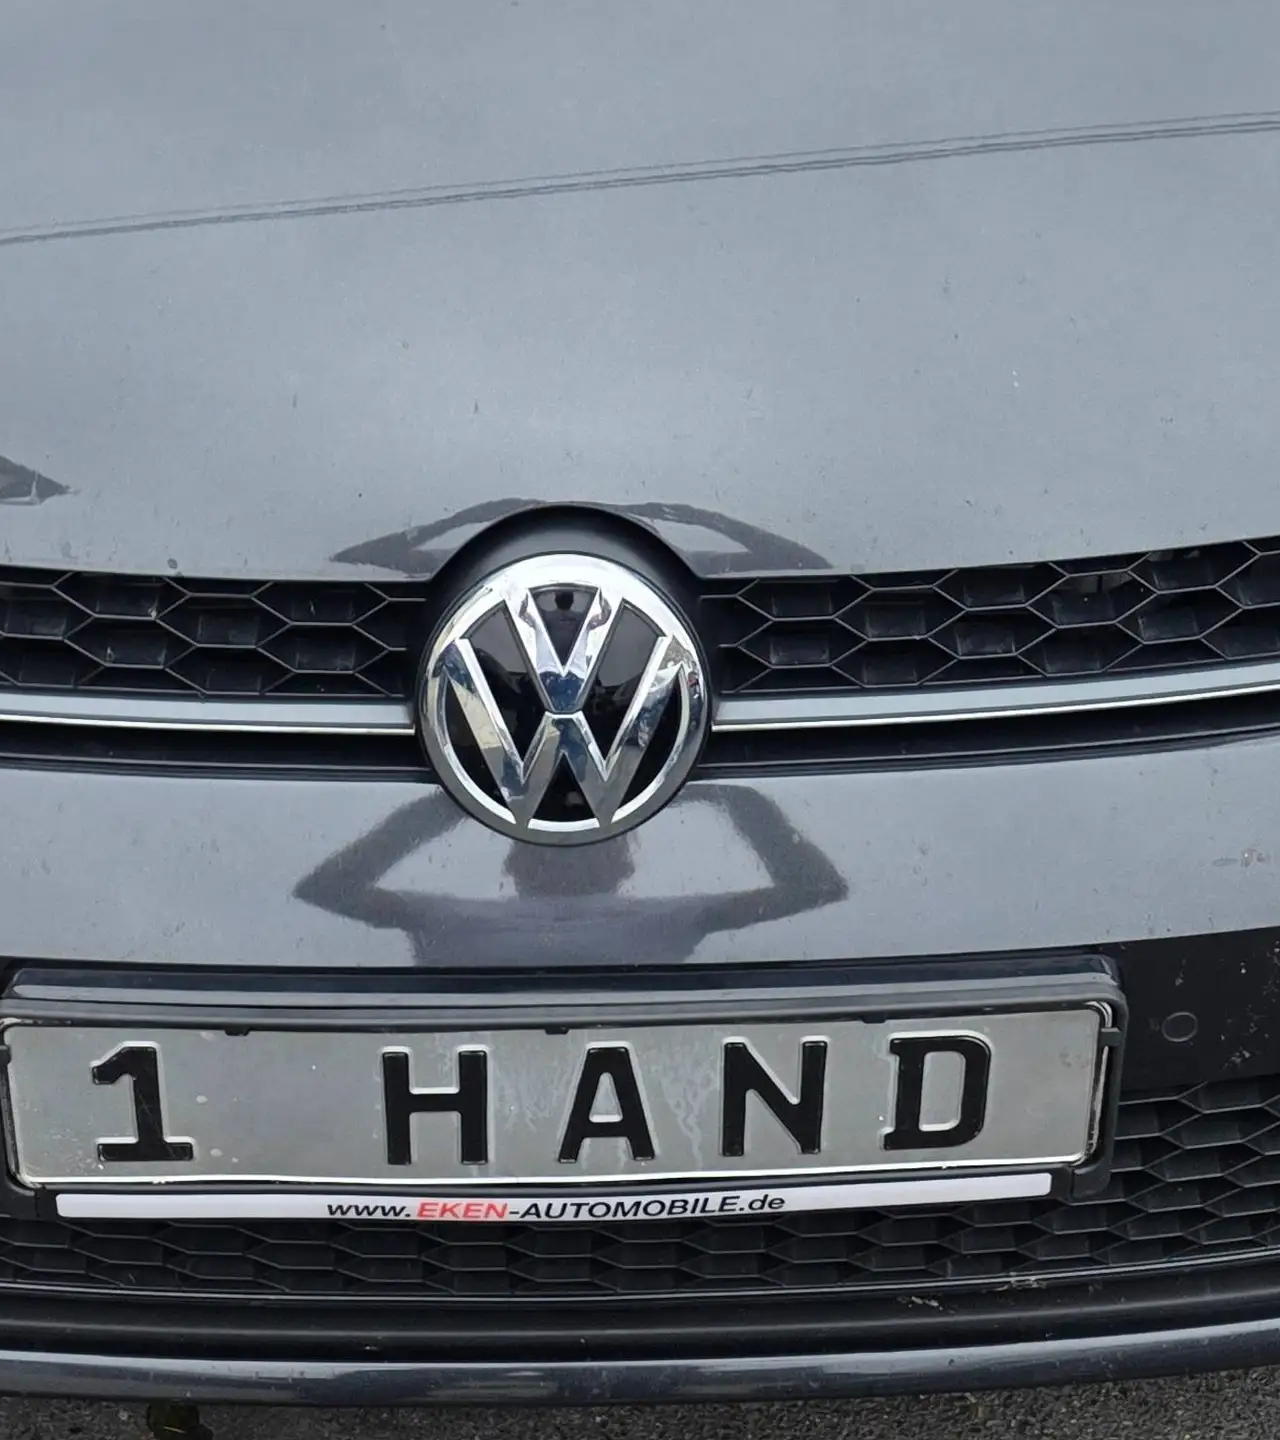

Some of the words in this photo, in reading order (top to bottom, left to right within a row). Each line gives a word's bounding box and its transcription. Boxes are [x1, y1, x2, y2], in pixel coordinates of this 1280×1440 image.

[90, 1040, 195, 1162] 1
[380, 1032, 993, 1165] HAND
[326, 1195, 786, 1221] www.EKEN-AUTOMOBILE.de
